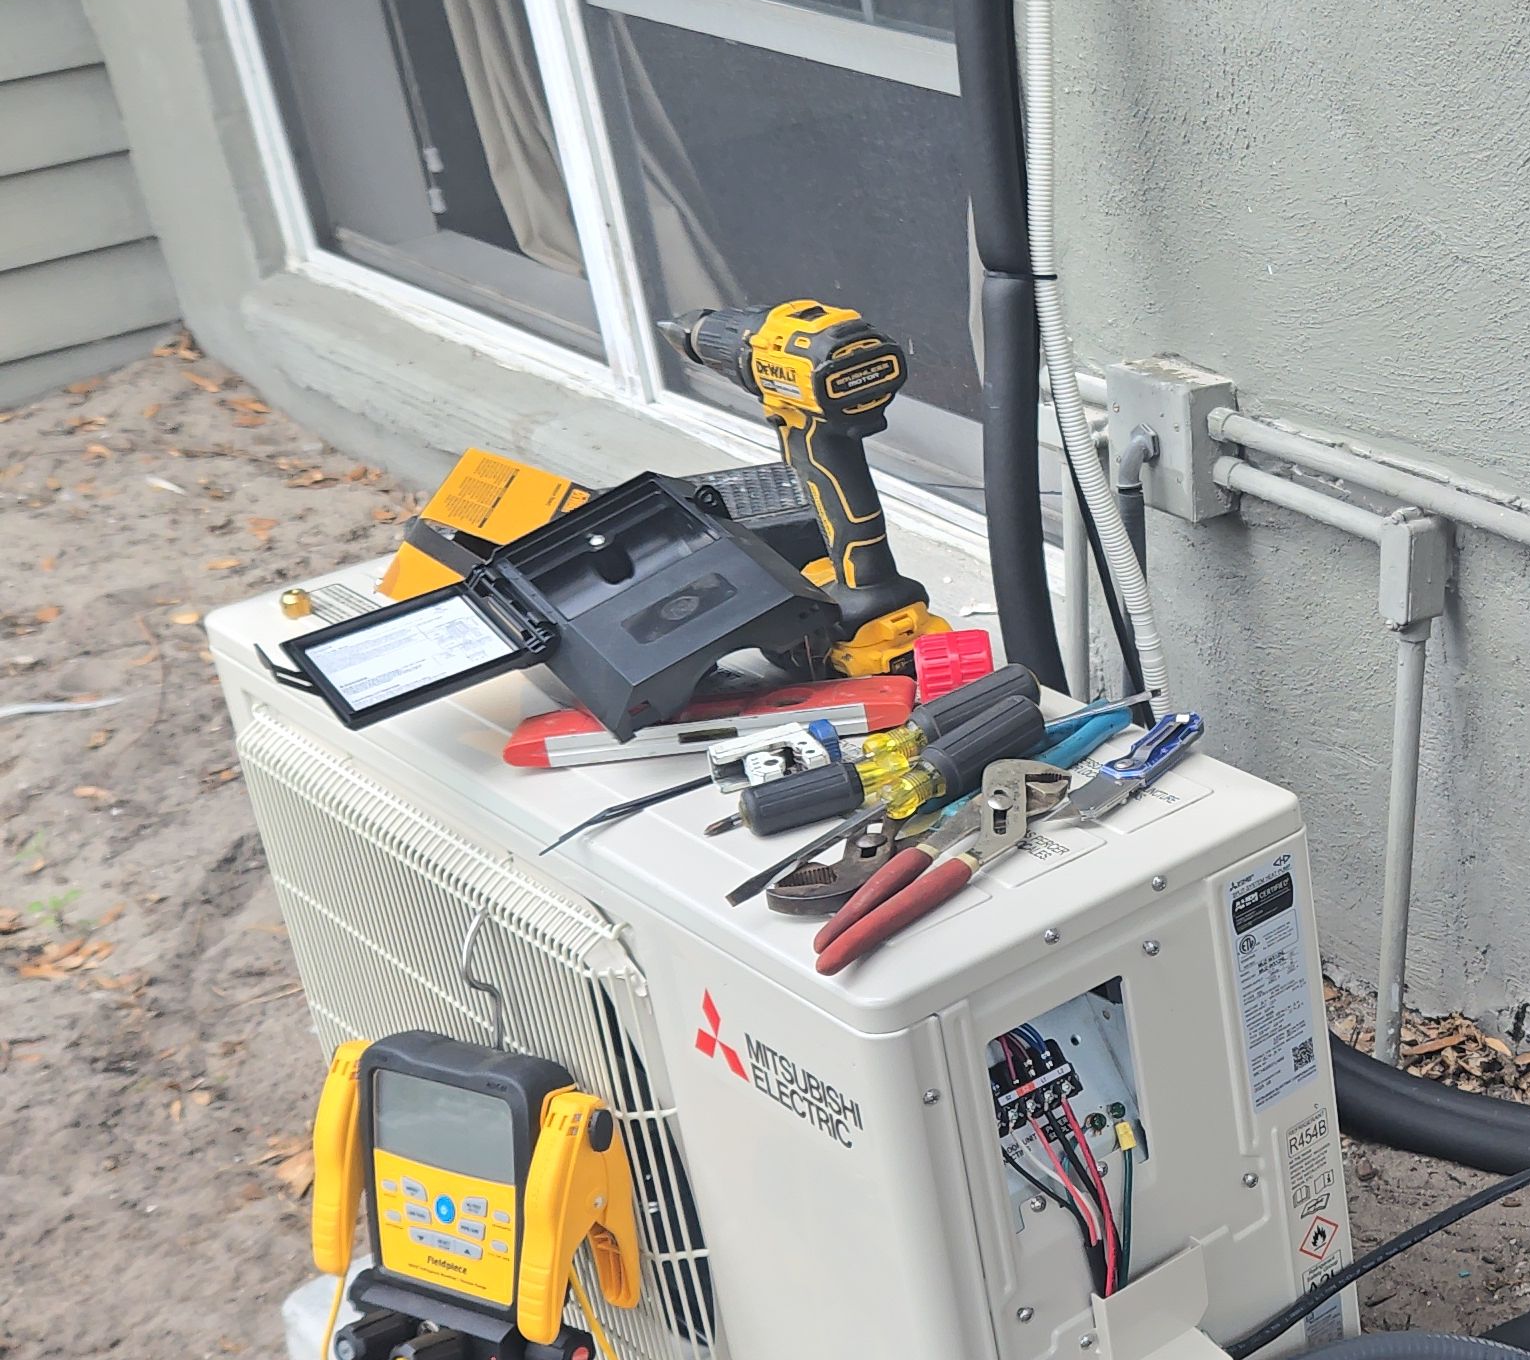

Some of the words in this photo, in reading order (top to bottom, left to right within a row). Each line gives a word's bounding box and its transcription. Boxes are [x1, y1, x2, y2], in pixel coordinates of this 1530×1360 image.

[848, 373, 881, 388] MOTOR
[744, 1032, 864, 1130] MITSUBISHI
[750, 1062, 852, 1148] ELECTRIC
[1289, 1120, 1327, 1154] R454B
[426, 1255, 468, 1274] Fieldpiece
